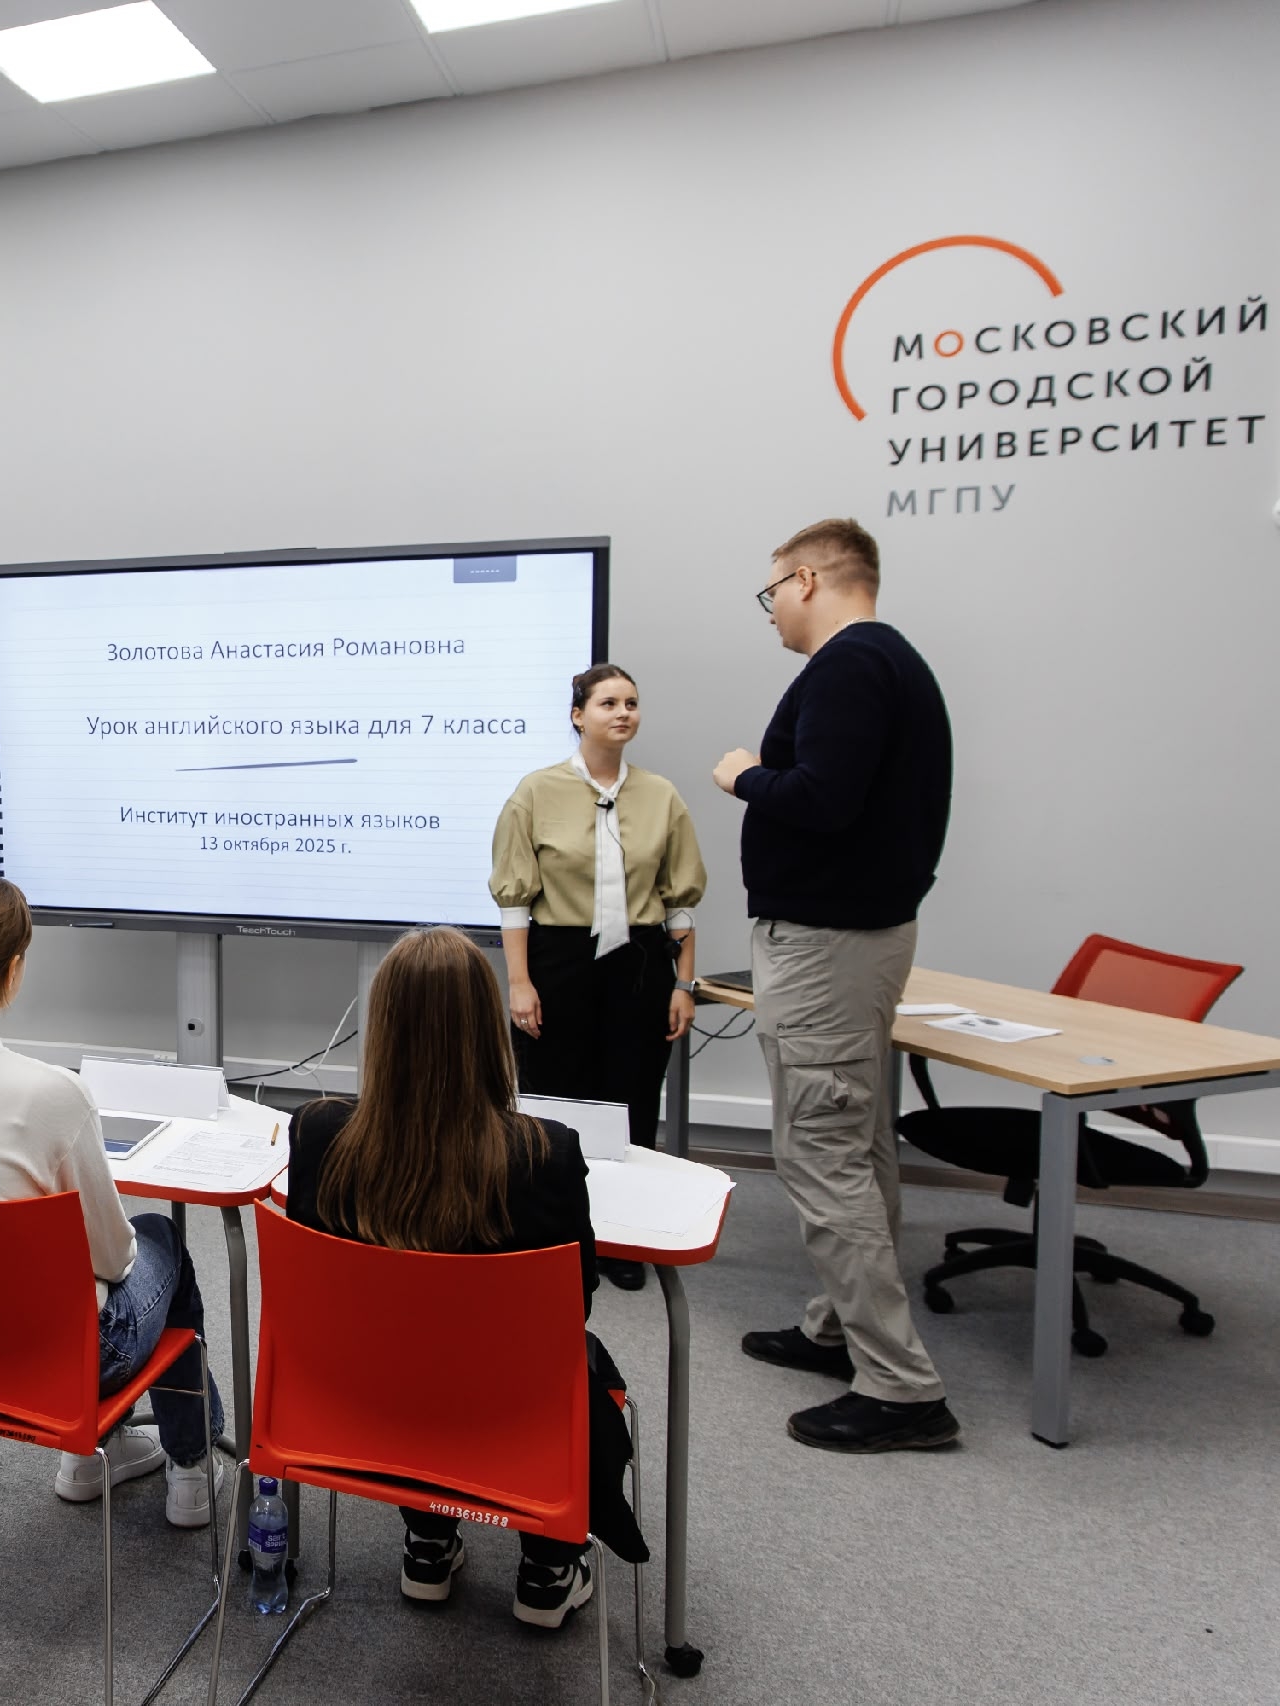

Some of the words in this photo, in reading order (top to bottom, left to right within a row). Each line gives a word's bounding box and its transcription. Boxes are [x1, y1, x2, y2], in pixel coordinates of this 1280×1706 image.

[892, 295, 1269, 363] МОСКОВСКИЙ
[891, 356, 1214, 414] ГОРОДСКОЙ
[888, 415, 1267, 466] УНИВЕРСИТЕТ
[886, 483, 1017, 518] МГПУ
[107, 643, 204, 662] Золотова
[210, 640, 325, 660] Анастасия
[333, 637, 466, 657] Романовна
[86, 716, 139, 740] Урок
[144, 715, 284, 735] английского
[290, 719, 360, 735] языка
[368, 719, 412, 739] для
[421, 715, 434, 735] 7
[444, 717, 527, 735] класса
[120, 806, 208, 828] Институт
[215, 811, 354, 830] иностранных
[361, 814, 441, 829] языков
[199, 836, 219, 850] 13
[223, 837, 289, 855] октября
[295, 838, 336, 853] 2025
[341, 842, 352, 853] г.
